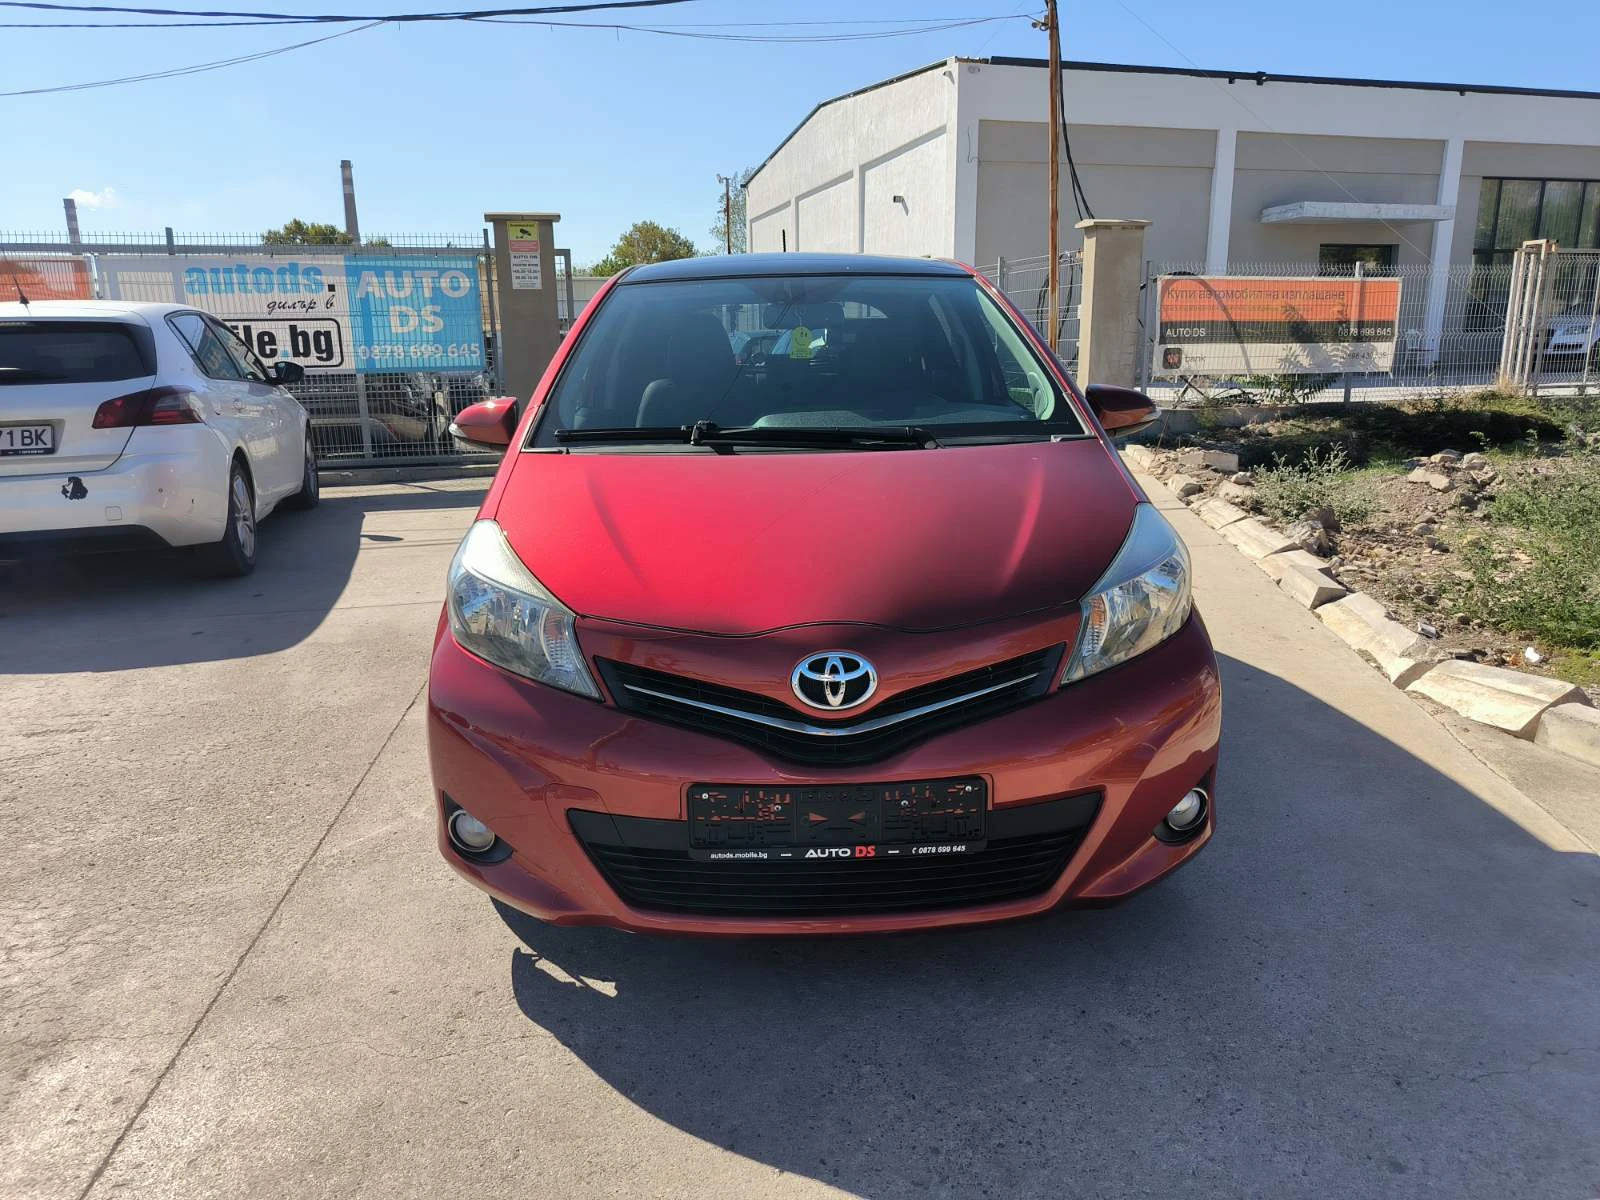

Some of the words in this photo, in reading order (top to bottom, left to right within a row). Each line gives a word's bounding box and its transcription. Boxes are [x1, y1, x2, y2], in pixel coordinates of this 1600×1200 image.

[356, 270, 471, 298] AUTO
[1167, 288, 1195, 301] Купи
[266, 299, 318, 315] дилър
[390, 305, 444, 333] DS
[1165, 328, 1192, 337] AUTO
[1193, 328, 1206, 337] DS
[1376, 327, 1392, 336] 645
[359, 344, 405, 360] 0878
[410, 344, 443, 359] 699
[447, 343, 480, 357] 645
[21, 429, 48, 446] BK
[710, 851, 768, 859] autods.mobile.bg
[804, 848, 851, 858] AUTO
[855, 845, 876, 858] DS
[918, 846, 936, 854] 0878
[937, 845, 951, 853] 699
